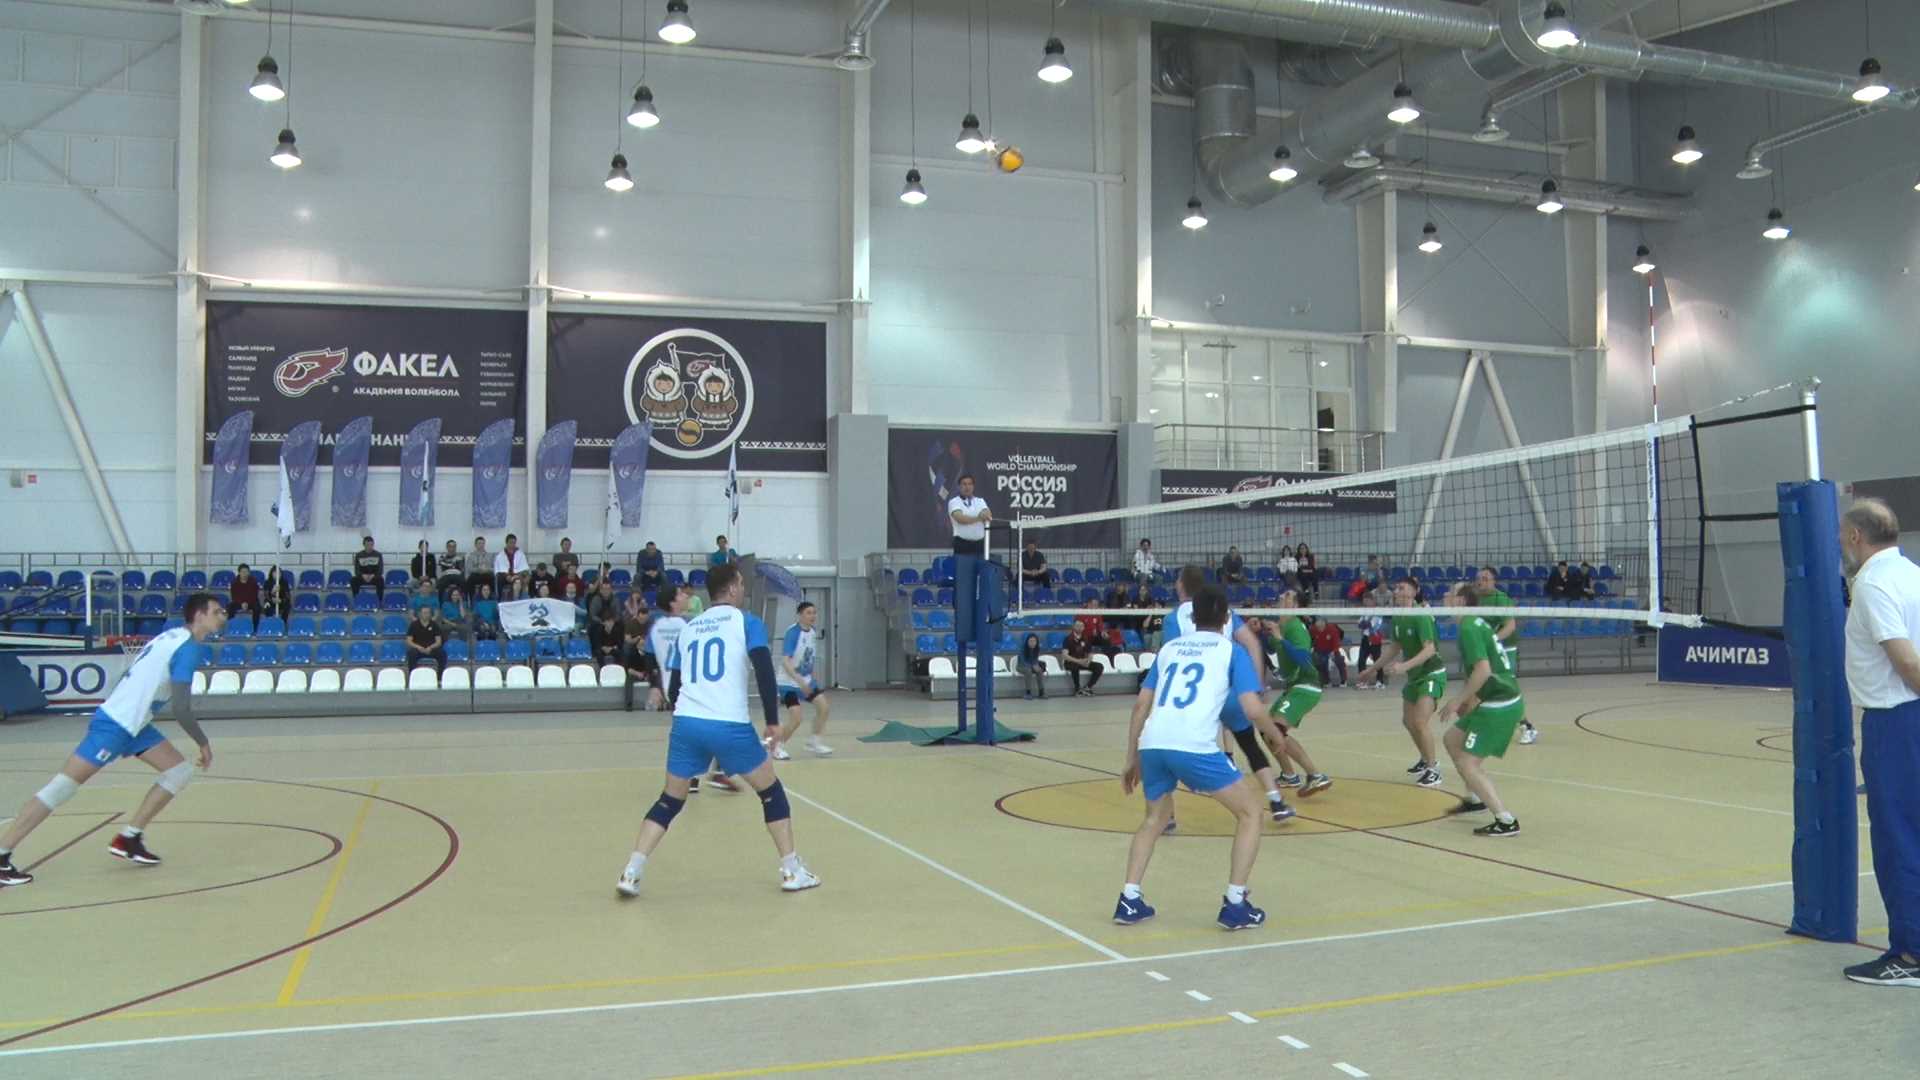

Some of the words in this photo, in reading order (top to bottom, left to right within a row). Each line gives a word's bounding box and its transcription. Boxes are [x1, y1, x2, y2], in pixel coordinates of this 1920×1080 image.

[353, 351, 460, 378] ФАКЕЛ
[353, 387, 403, 396] АКАДЕМИЯ
[404, 387, 460, 397] ВОЛЕЙБОЛА
[986, 462, 1016, 471] WORLD
[1017, 463, 1077, 472] CHAMPIONSHIP
[1008, 455, 1056, 464] VOLLEYBALL
[997, 475, 1067, 492] РОССИЯ
[1010, 492, 1056, 508] 2022
[687, 637, 726, 684] 10
[1685, 645, 1770, 665] АЧИМГАЗ
[23, 663, 106, 695] DO
[1158, 662, 1205, 709] 13
[1428, 680, 1434, 693] 1
[1279, 700, 1291, 713] 2
[1465, 731, 1478, 750] 5
